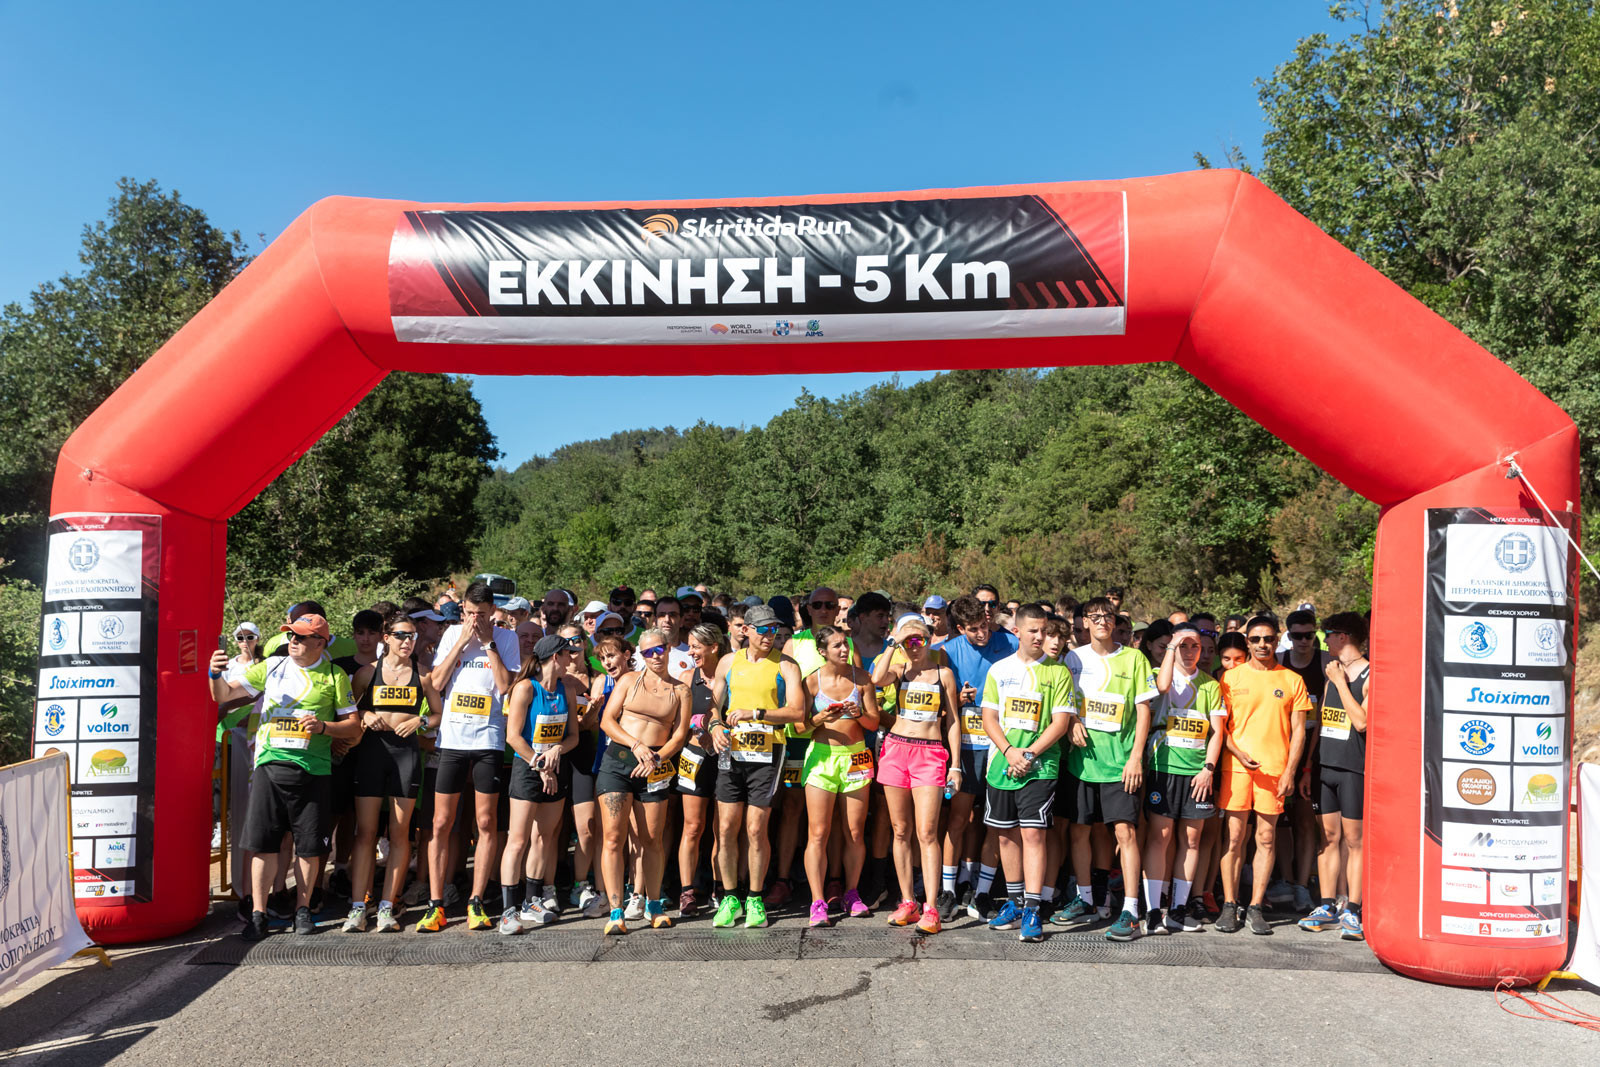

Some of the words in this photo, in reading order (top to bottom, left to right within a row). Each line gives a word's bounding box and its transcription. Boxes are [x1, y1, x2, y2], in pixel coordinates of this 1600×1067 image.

[680, 214, 852, 240] SkiritidaRun
[488, 256, 806, 305] ΕΚΚΙΝΗΣΗ
[819, 274, 842, 288] -
[853, 254, 891, 303] 5
[905, 252, 1010, 301] Km
[1470, 578, 1510, 586] ΕΛΛΗΝΙΚΗ
[1451, 587, 1503, 596] ΠΕΡΙΦΕΡΕΙΑ
[49, 675, 115, 690] Stoiximan
[380, 687, 410, 699] 5930
[906, 691, 933, 706] 5912
[1466, 687, 1550, 706] Stoiximan
[456, 694, 486, 709] 5986
[1011, 699, 1040, 714] 5973
[1087, 700, 1117, 716] 5903
[1323, 708, 1347, 723] 5389
[87, 722, 130, 733] volton
[541, 724, 564, 738] 5326
[1173, 718, 1204, 733] 5055
[1522, 743, 1560, 756] volton
